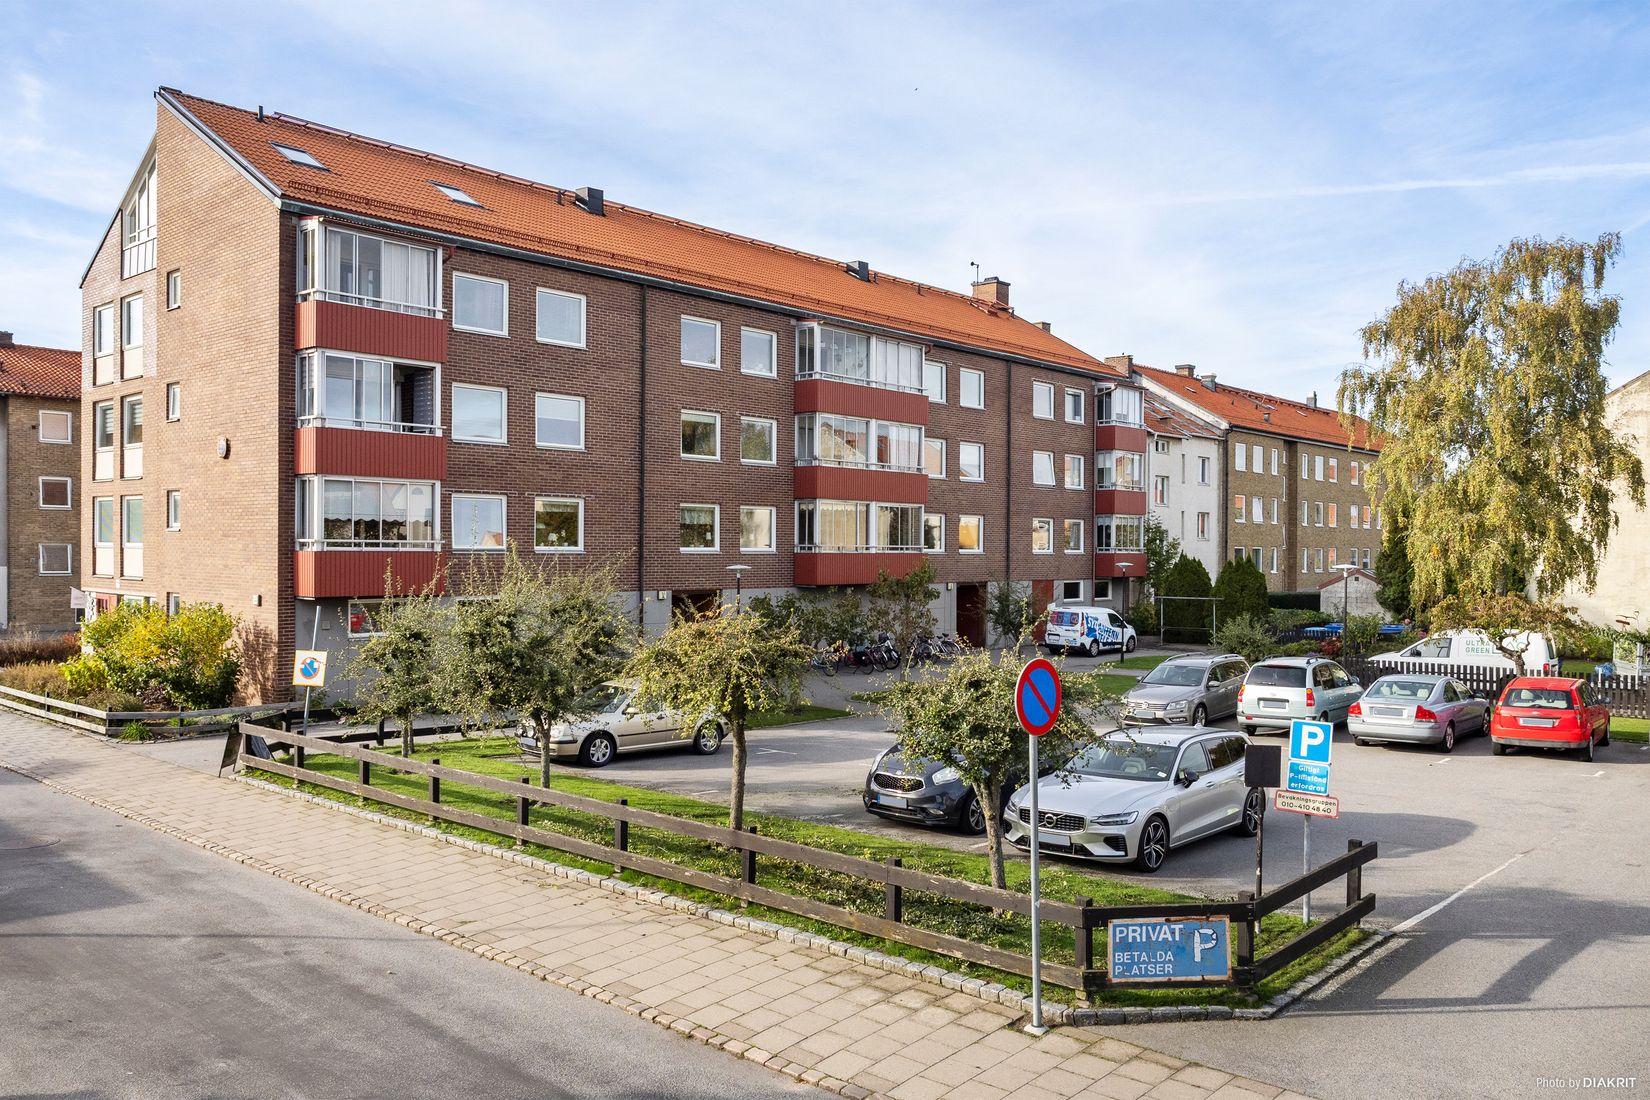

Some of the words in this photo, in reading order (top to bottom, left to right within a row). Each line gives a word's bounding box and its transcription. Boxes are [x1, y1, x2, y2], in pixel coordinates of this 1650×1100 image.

[1465, 639, 1490, 647] ULTRA
[1465, 646, 1490, 654] GREEN
[1300, 724, 1325, 757] P
[1290, 782, 1325, 792] erfordras
[1277, 793, 1337, 807] Bevakningsgruppen
[1281, 800, 1311, 811] 010-410
[1115, 924, 1184, 943] PRIVAT
[1193, 928, 1218, 962] P
